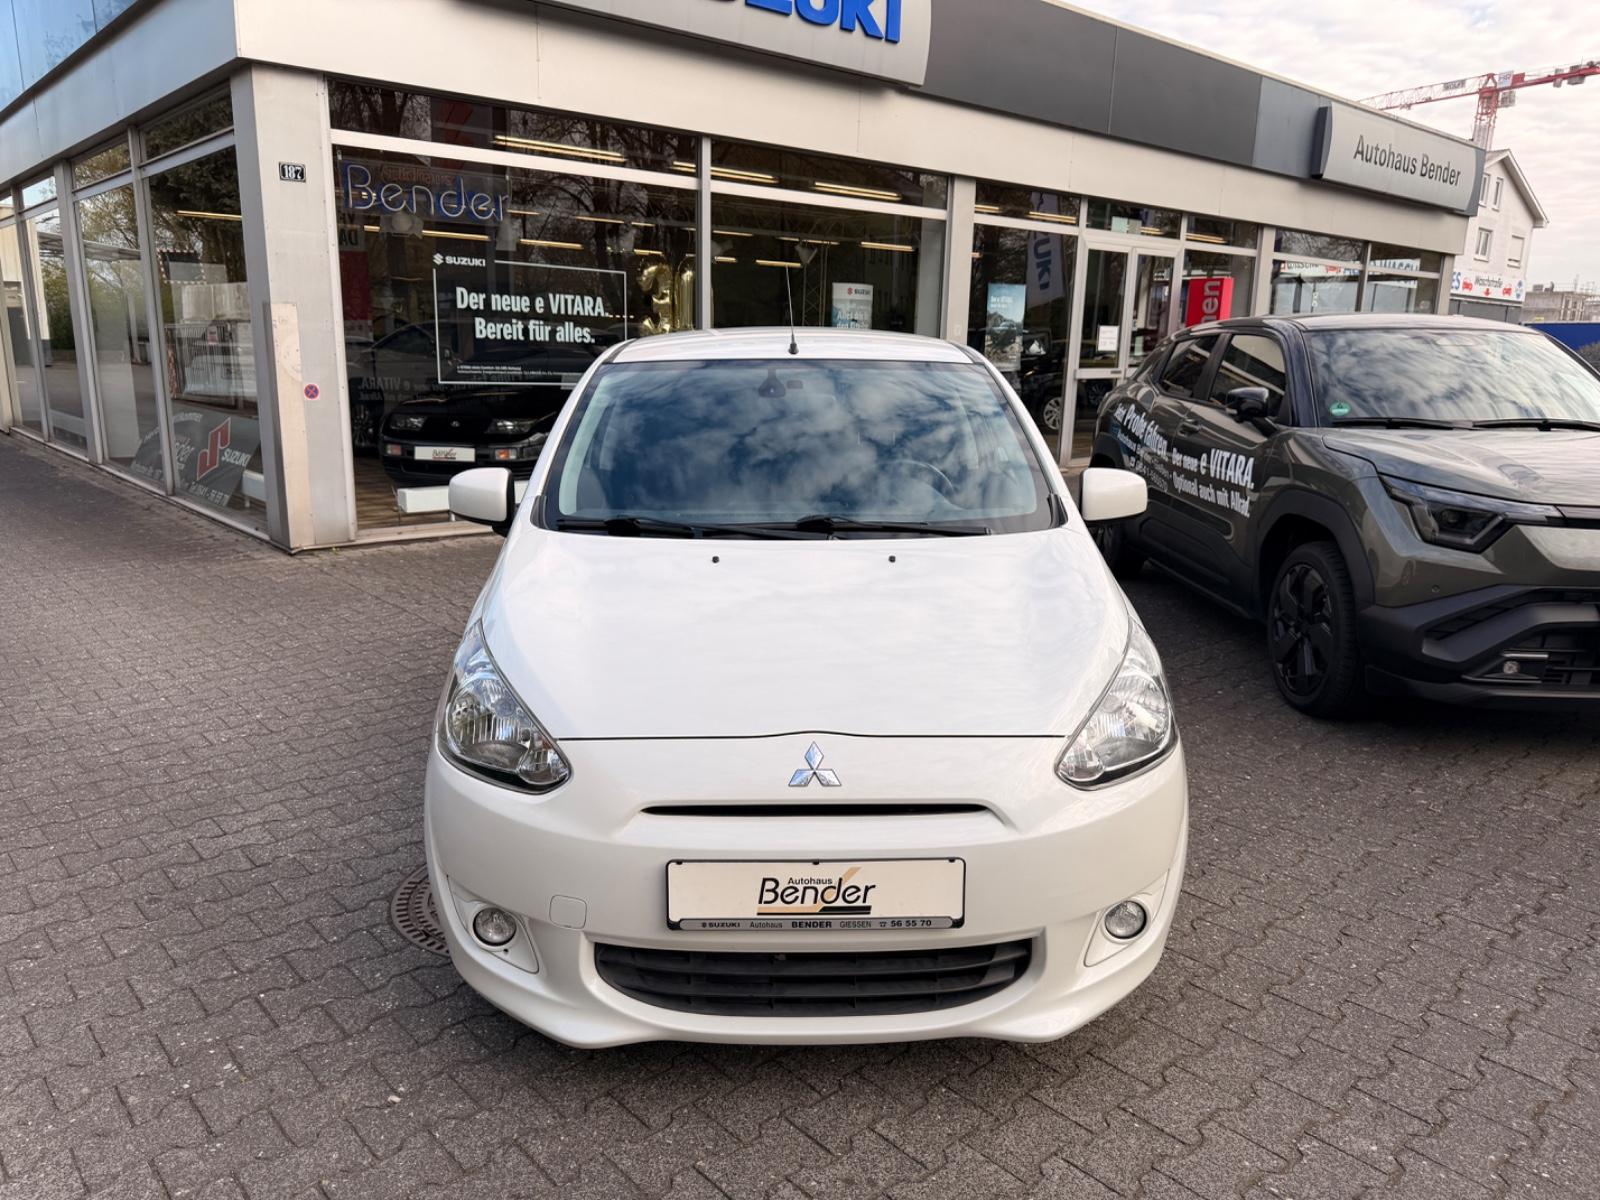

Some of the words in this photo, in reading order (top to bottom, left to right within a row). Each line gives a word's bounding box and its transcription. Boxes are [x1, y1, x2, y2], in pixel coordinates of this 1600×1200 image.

[283, 164, 302, 180] 187
[1353, 134, 1417, 175] Autohaus
[1420, 153, 1461, 186] Bender
[345, 163, 509, 222] Bender
[445, 256, 486, 267] SUZUKI
[456, 287, 486, 311] Der
[491, 294, 531, 313] neue
[535, 298, 545, 313] e
[549, 293, 609, 317] VITARA.
[475, 317, 525, 341] Bereit
[529, 321, 551, 341] für
[556, 322, 596, 343] alles.
[1124, 404, 1147, 439] Probe
[221, 447, 251, 467] SUZUKI
[1200, 453, 1208, 475] e
[1210, 448, 1255, 490] VITARA.
[1173, 471, 1198, 494] Optional
[1199, 484, 1216, 503] auch
[1216, 488, 1229, 508] mit
[758, 877, 876, 905] Bender
[788, 877, 833, 885] Autohaus
[749, 920, 783, 929] Autohaus
[791, 921, 832, 929] BENDER
